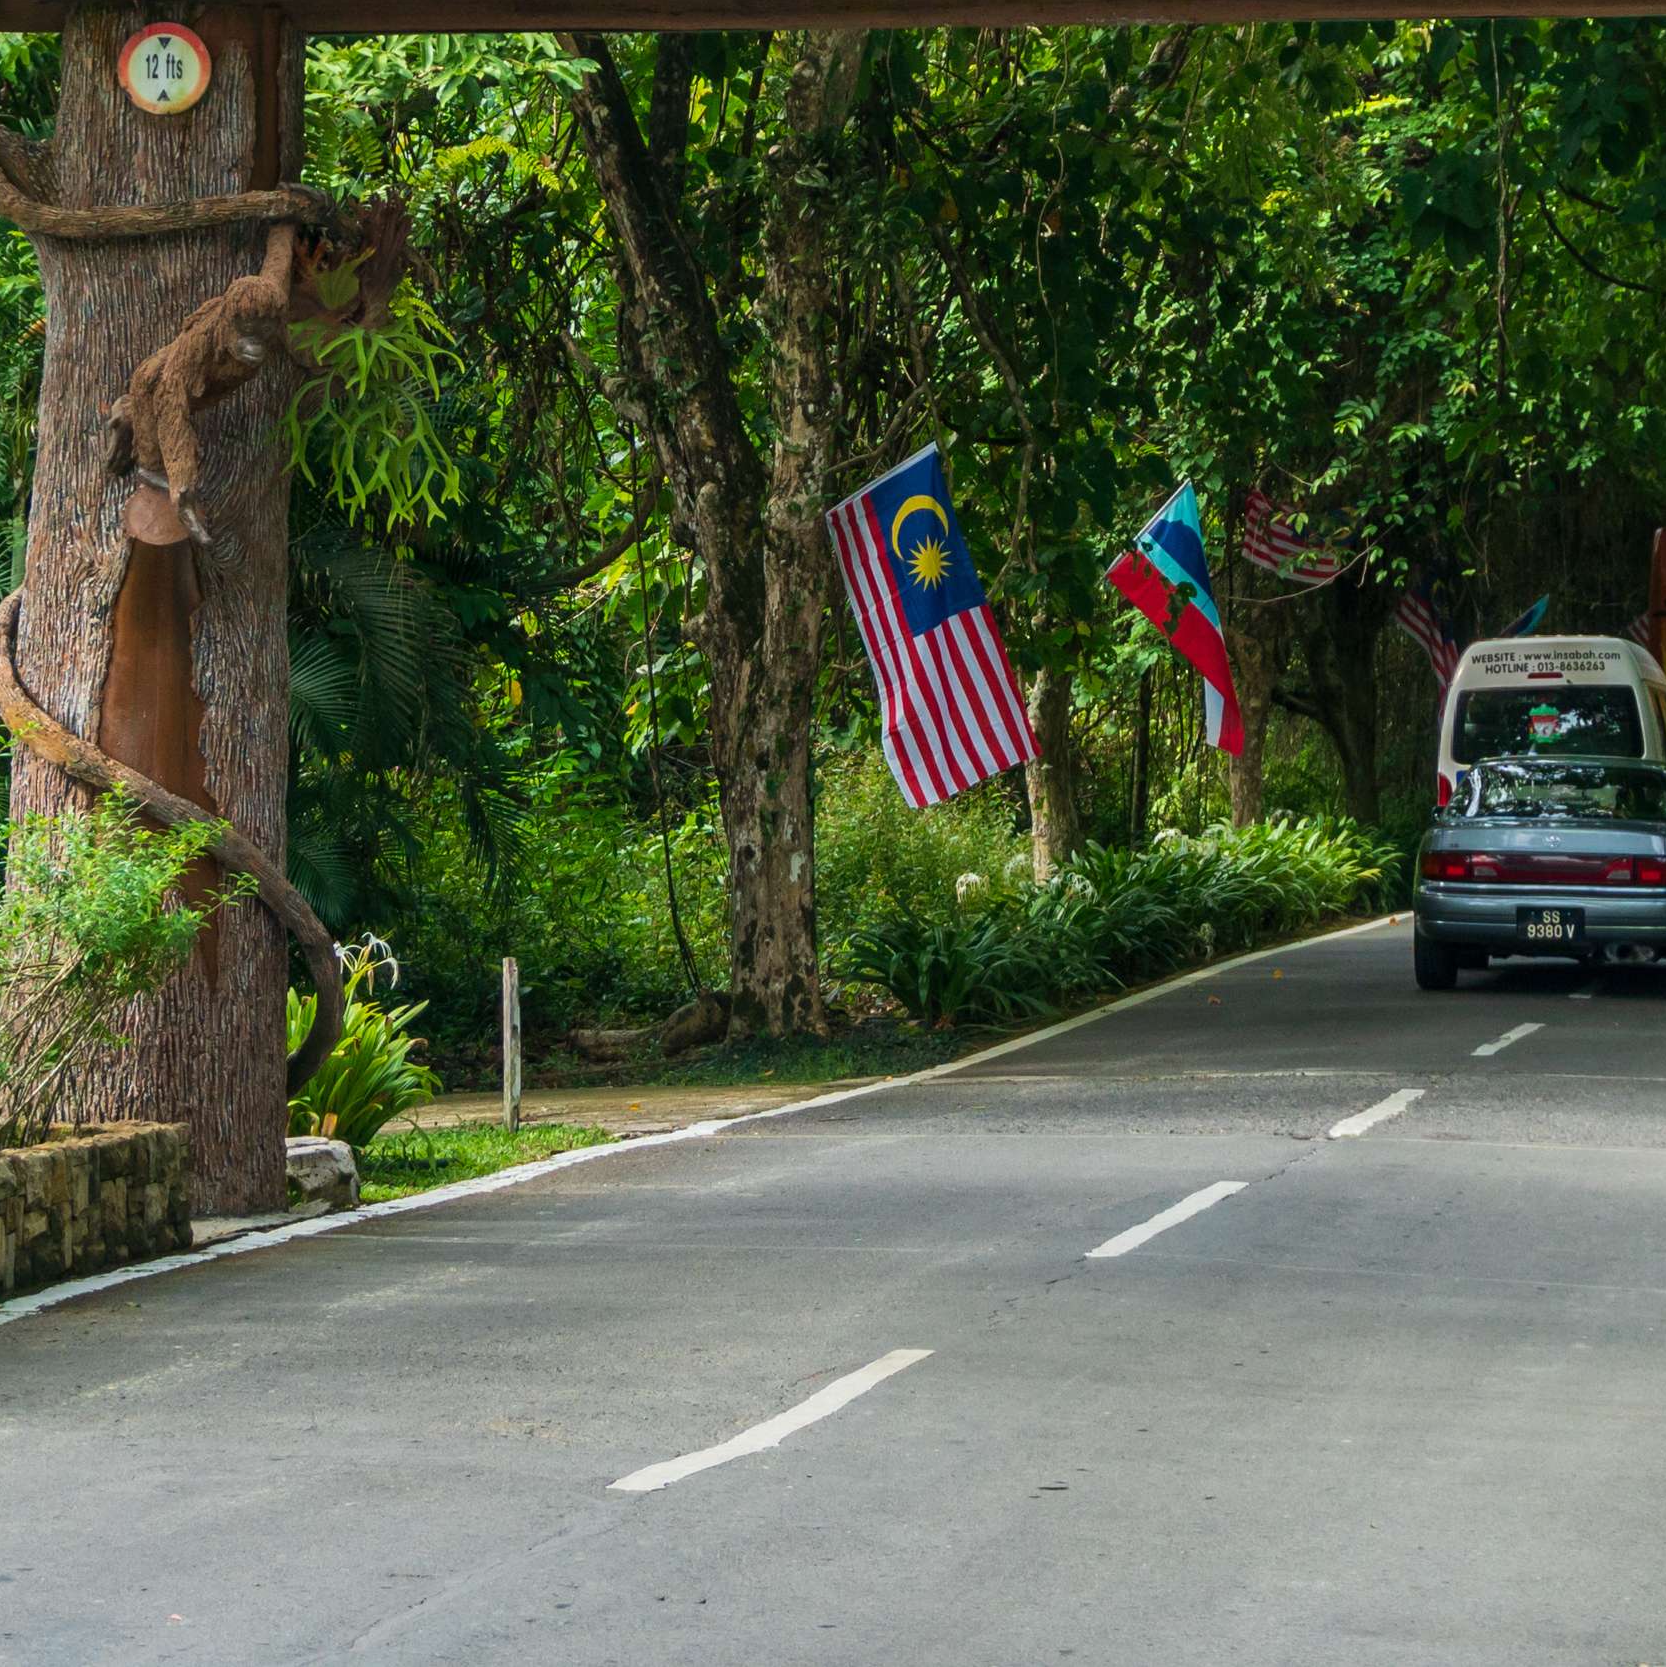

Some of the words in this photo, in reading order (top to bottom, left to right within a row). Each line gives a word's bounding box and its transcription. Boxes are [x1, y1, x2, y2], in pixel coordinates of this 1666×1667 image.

[145, 53, 159, 79] 12
[165, 52, 184, 80] fts
[1471, 652, 1516, 664] WEBSITE
[1523, 649, 1621, 661] www.insabah.com
[1485, 662, 1530, 675] HOTLINE
[1536, 660, 1606, 672] 013-8636263
[1542, 909, 1562, 924] SS
[1526, 923, 1564, 939] 9380
[1565, 923, 1576, 940] V
